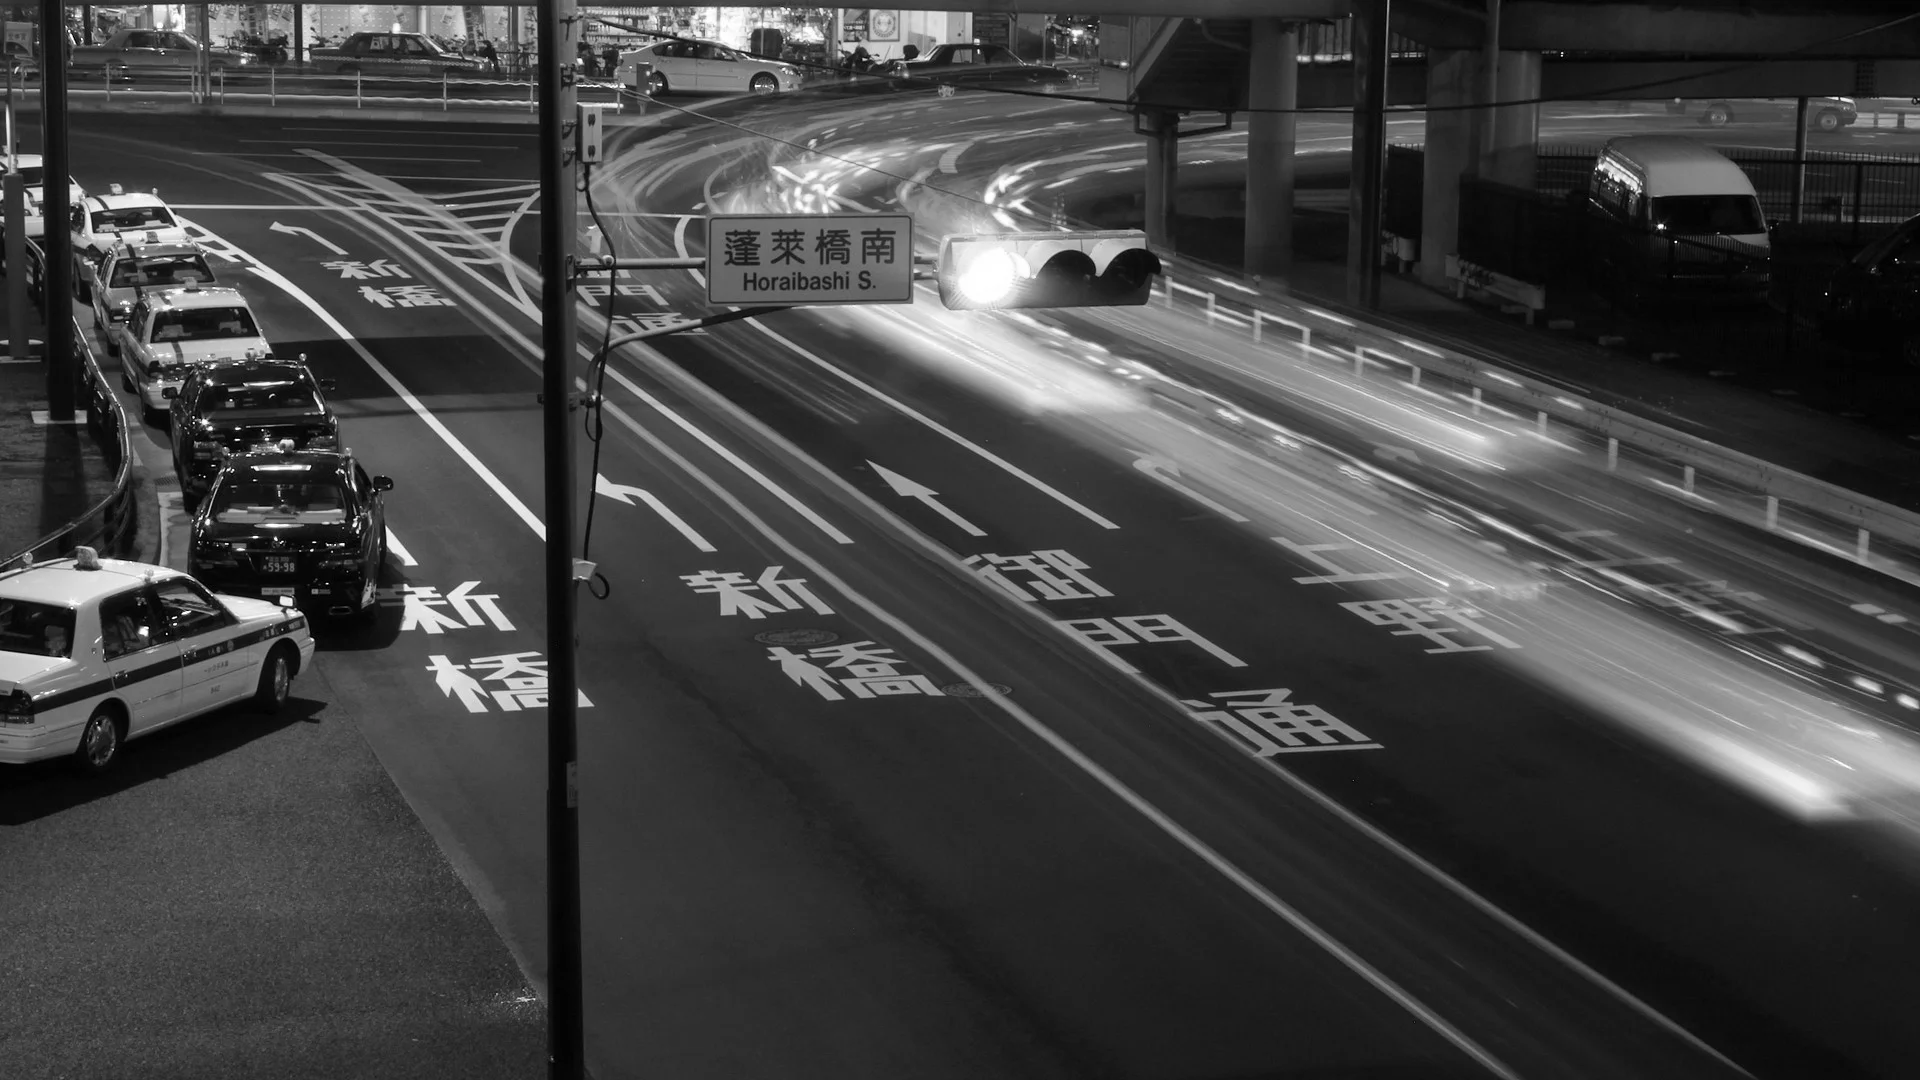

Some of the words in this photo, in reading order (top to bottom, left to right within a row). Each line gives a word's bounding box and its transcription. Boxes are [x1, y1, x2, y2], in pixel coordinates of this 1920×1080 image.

[724, 227, 897, 266] 蓬萊橋南
[743, 271, 849, 291] Horaibashi
[858, 270, 876, 290] S.
[679, 566, 947, 701] 新橋
